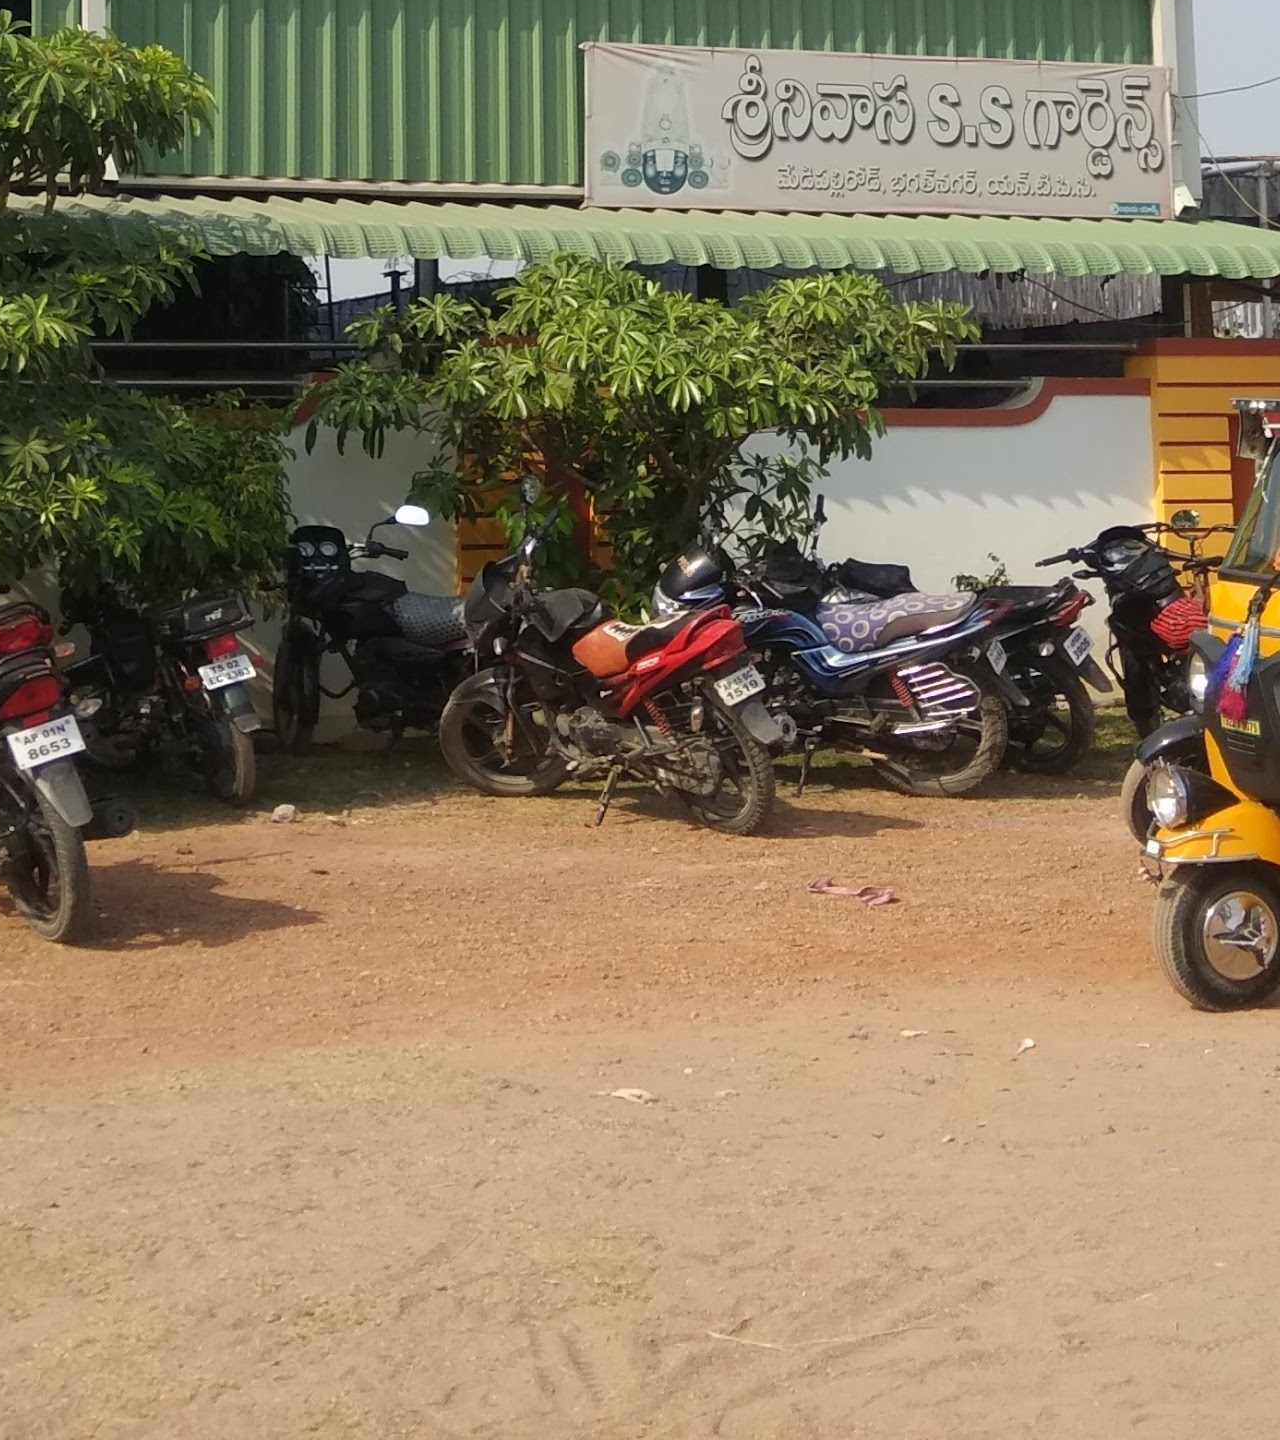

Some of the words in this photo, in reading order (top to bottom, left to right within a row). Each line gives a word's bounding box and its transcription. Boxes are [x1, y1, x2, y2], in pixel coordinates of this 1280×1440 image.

[721, 54, 917, 162] శ్రీనివాస
[926, 82, 1016, 148] S.S
[1022, 75, 1164, 178] గార్డెన్స్
[726, 679, 759, 701] 1519
[23, 733, 39, 746] AP
[27, 737, 72, 761] 8653
